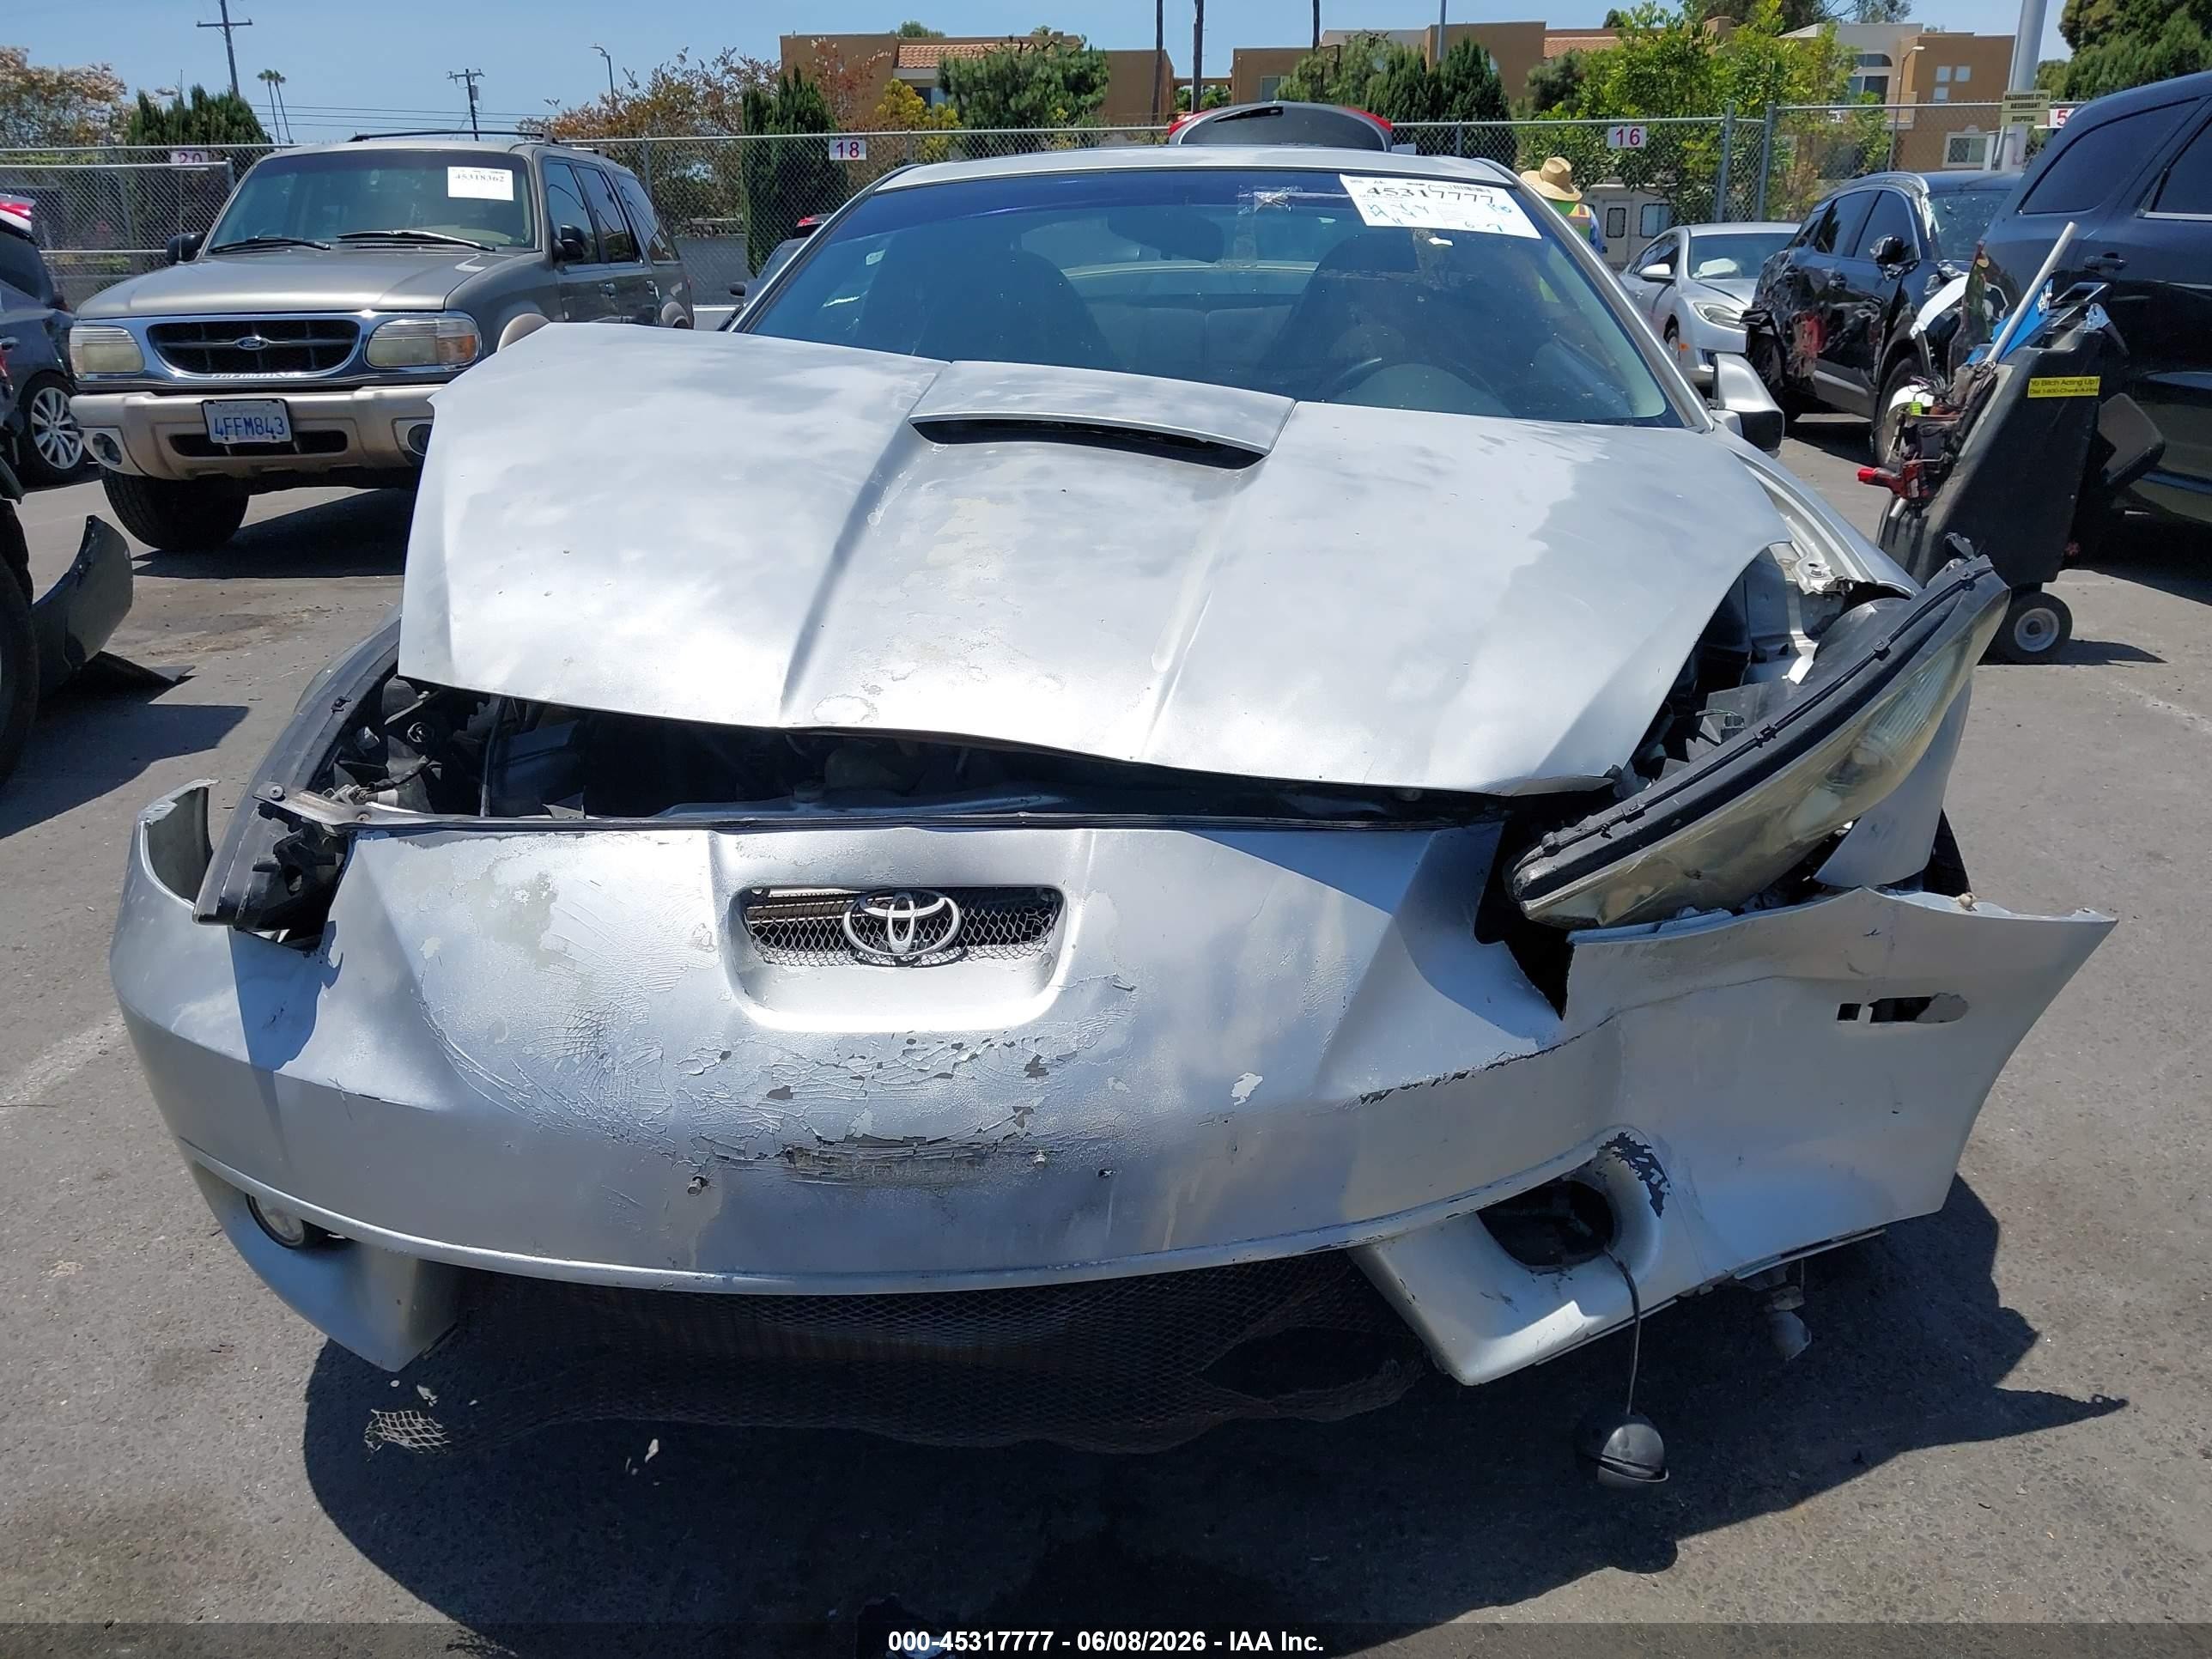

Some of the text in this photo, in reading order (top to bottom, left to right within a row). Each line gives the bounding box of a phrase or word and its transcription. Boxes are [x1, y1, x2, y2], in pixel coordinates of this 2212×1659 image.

[1616, 128, 1640, 146] 16
[178, 152, 203, 163] 20
[836, 142, 860, 158] 18
[1366, 186, 1494, 204] 45317777
[214, 416, 285, 436] 4FFM843
